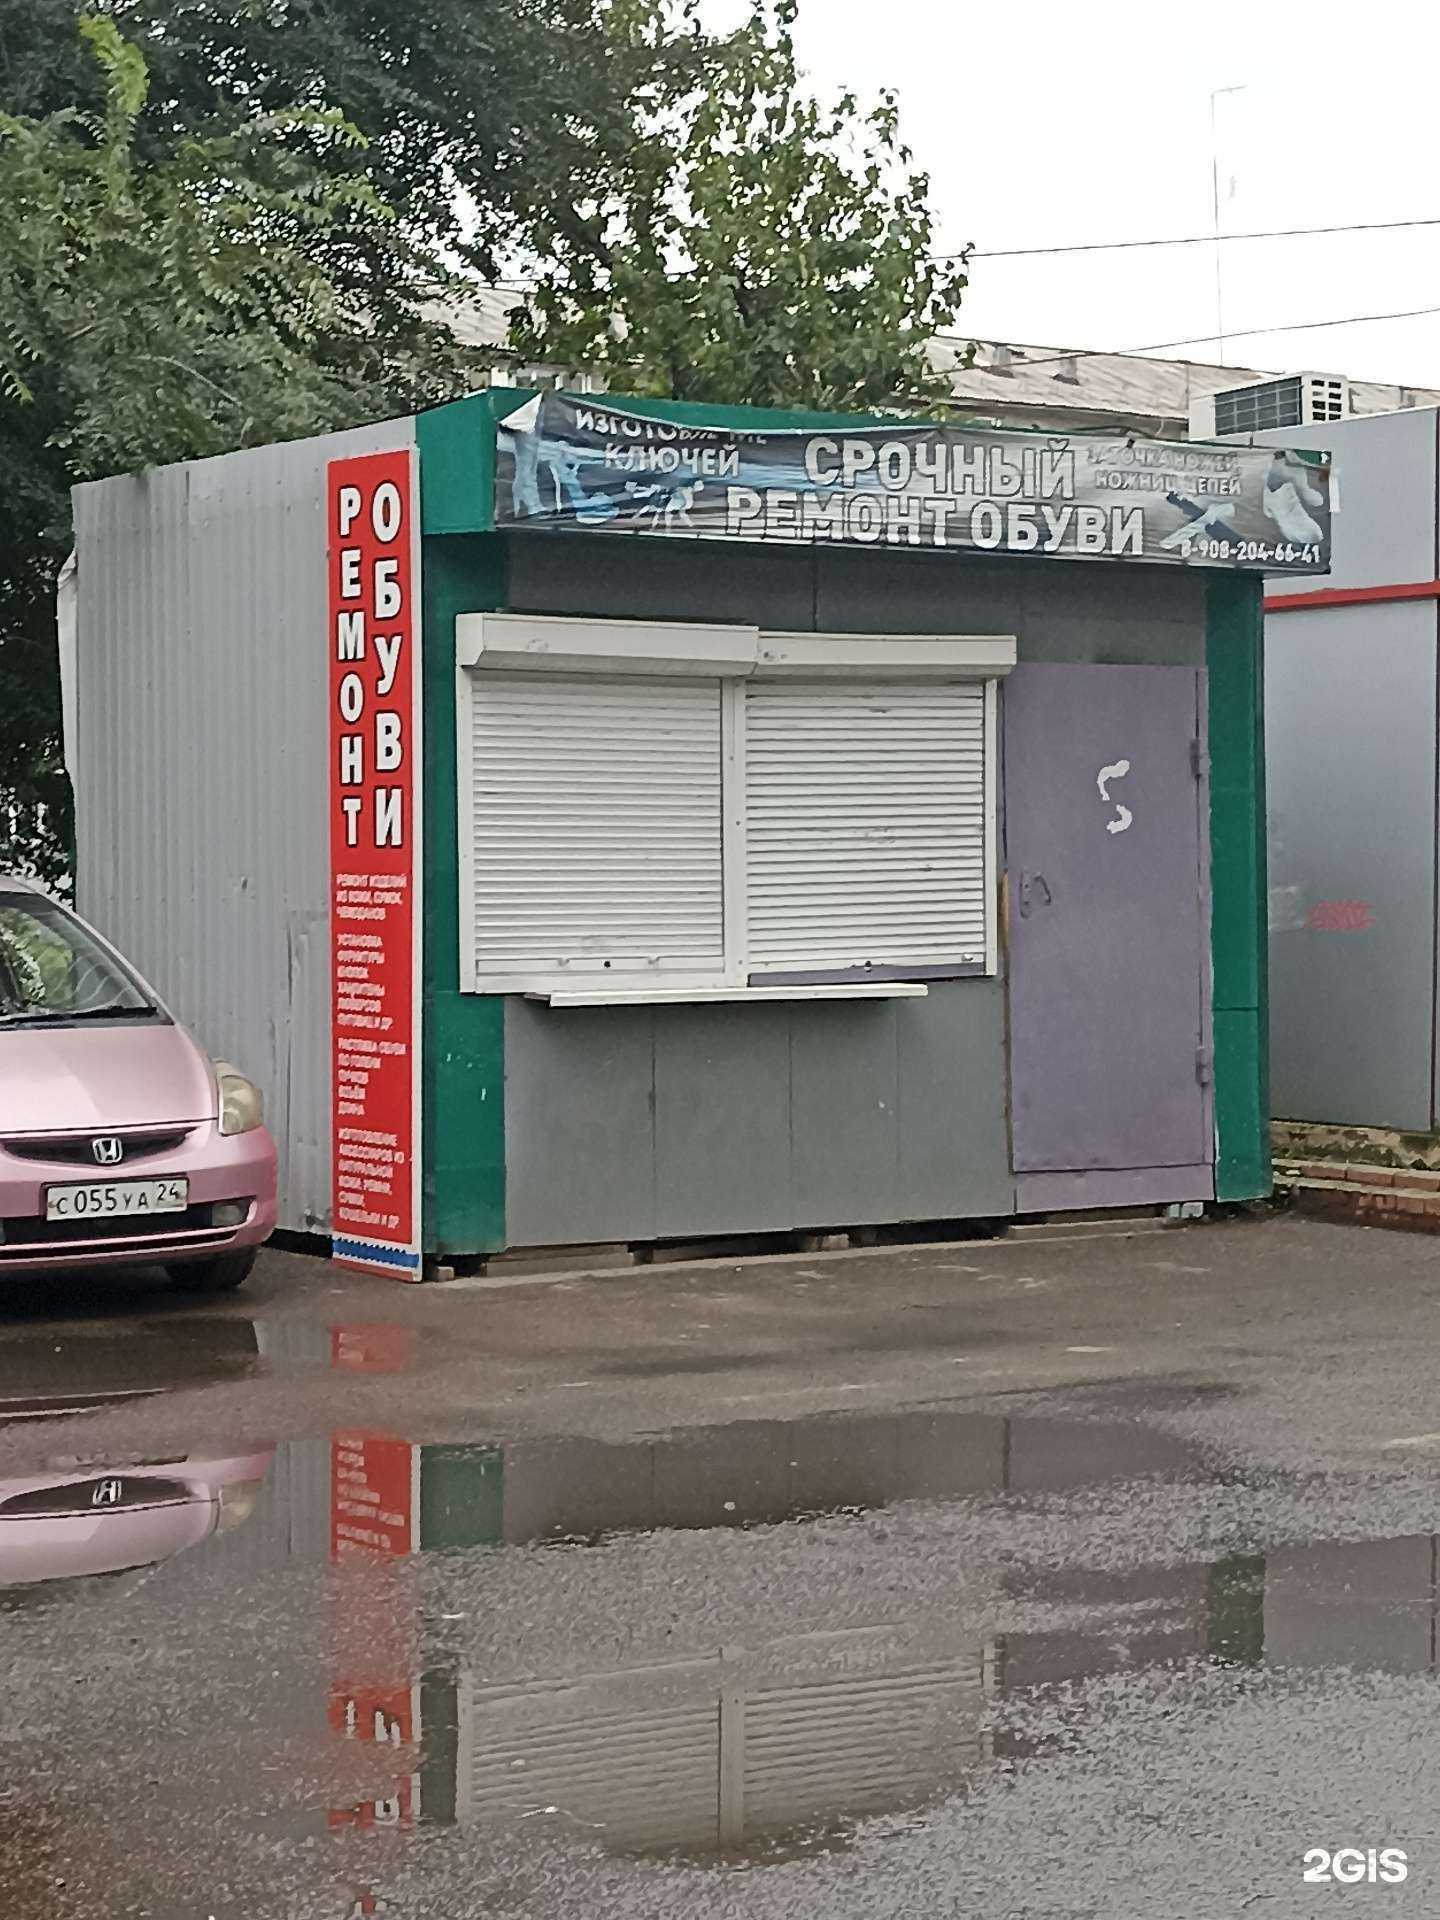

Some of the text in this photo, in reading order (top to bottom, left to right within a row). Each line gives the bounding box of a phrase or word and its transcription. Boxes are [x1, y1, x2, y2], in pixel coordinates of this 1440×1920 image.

[604, 443, 739, 476] КЛЮЧЕЙ
[804, 436, 1075, 498] СРОЧНЫЙ
[727, 486, 1145, 556] РЕМОНТ ОБУВИ
[337, 486, 365, 846] РЕМОНТ
[372, 481, 403, 847] ОБУВИ
